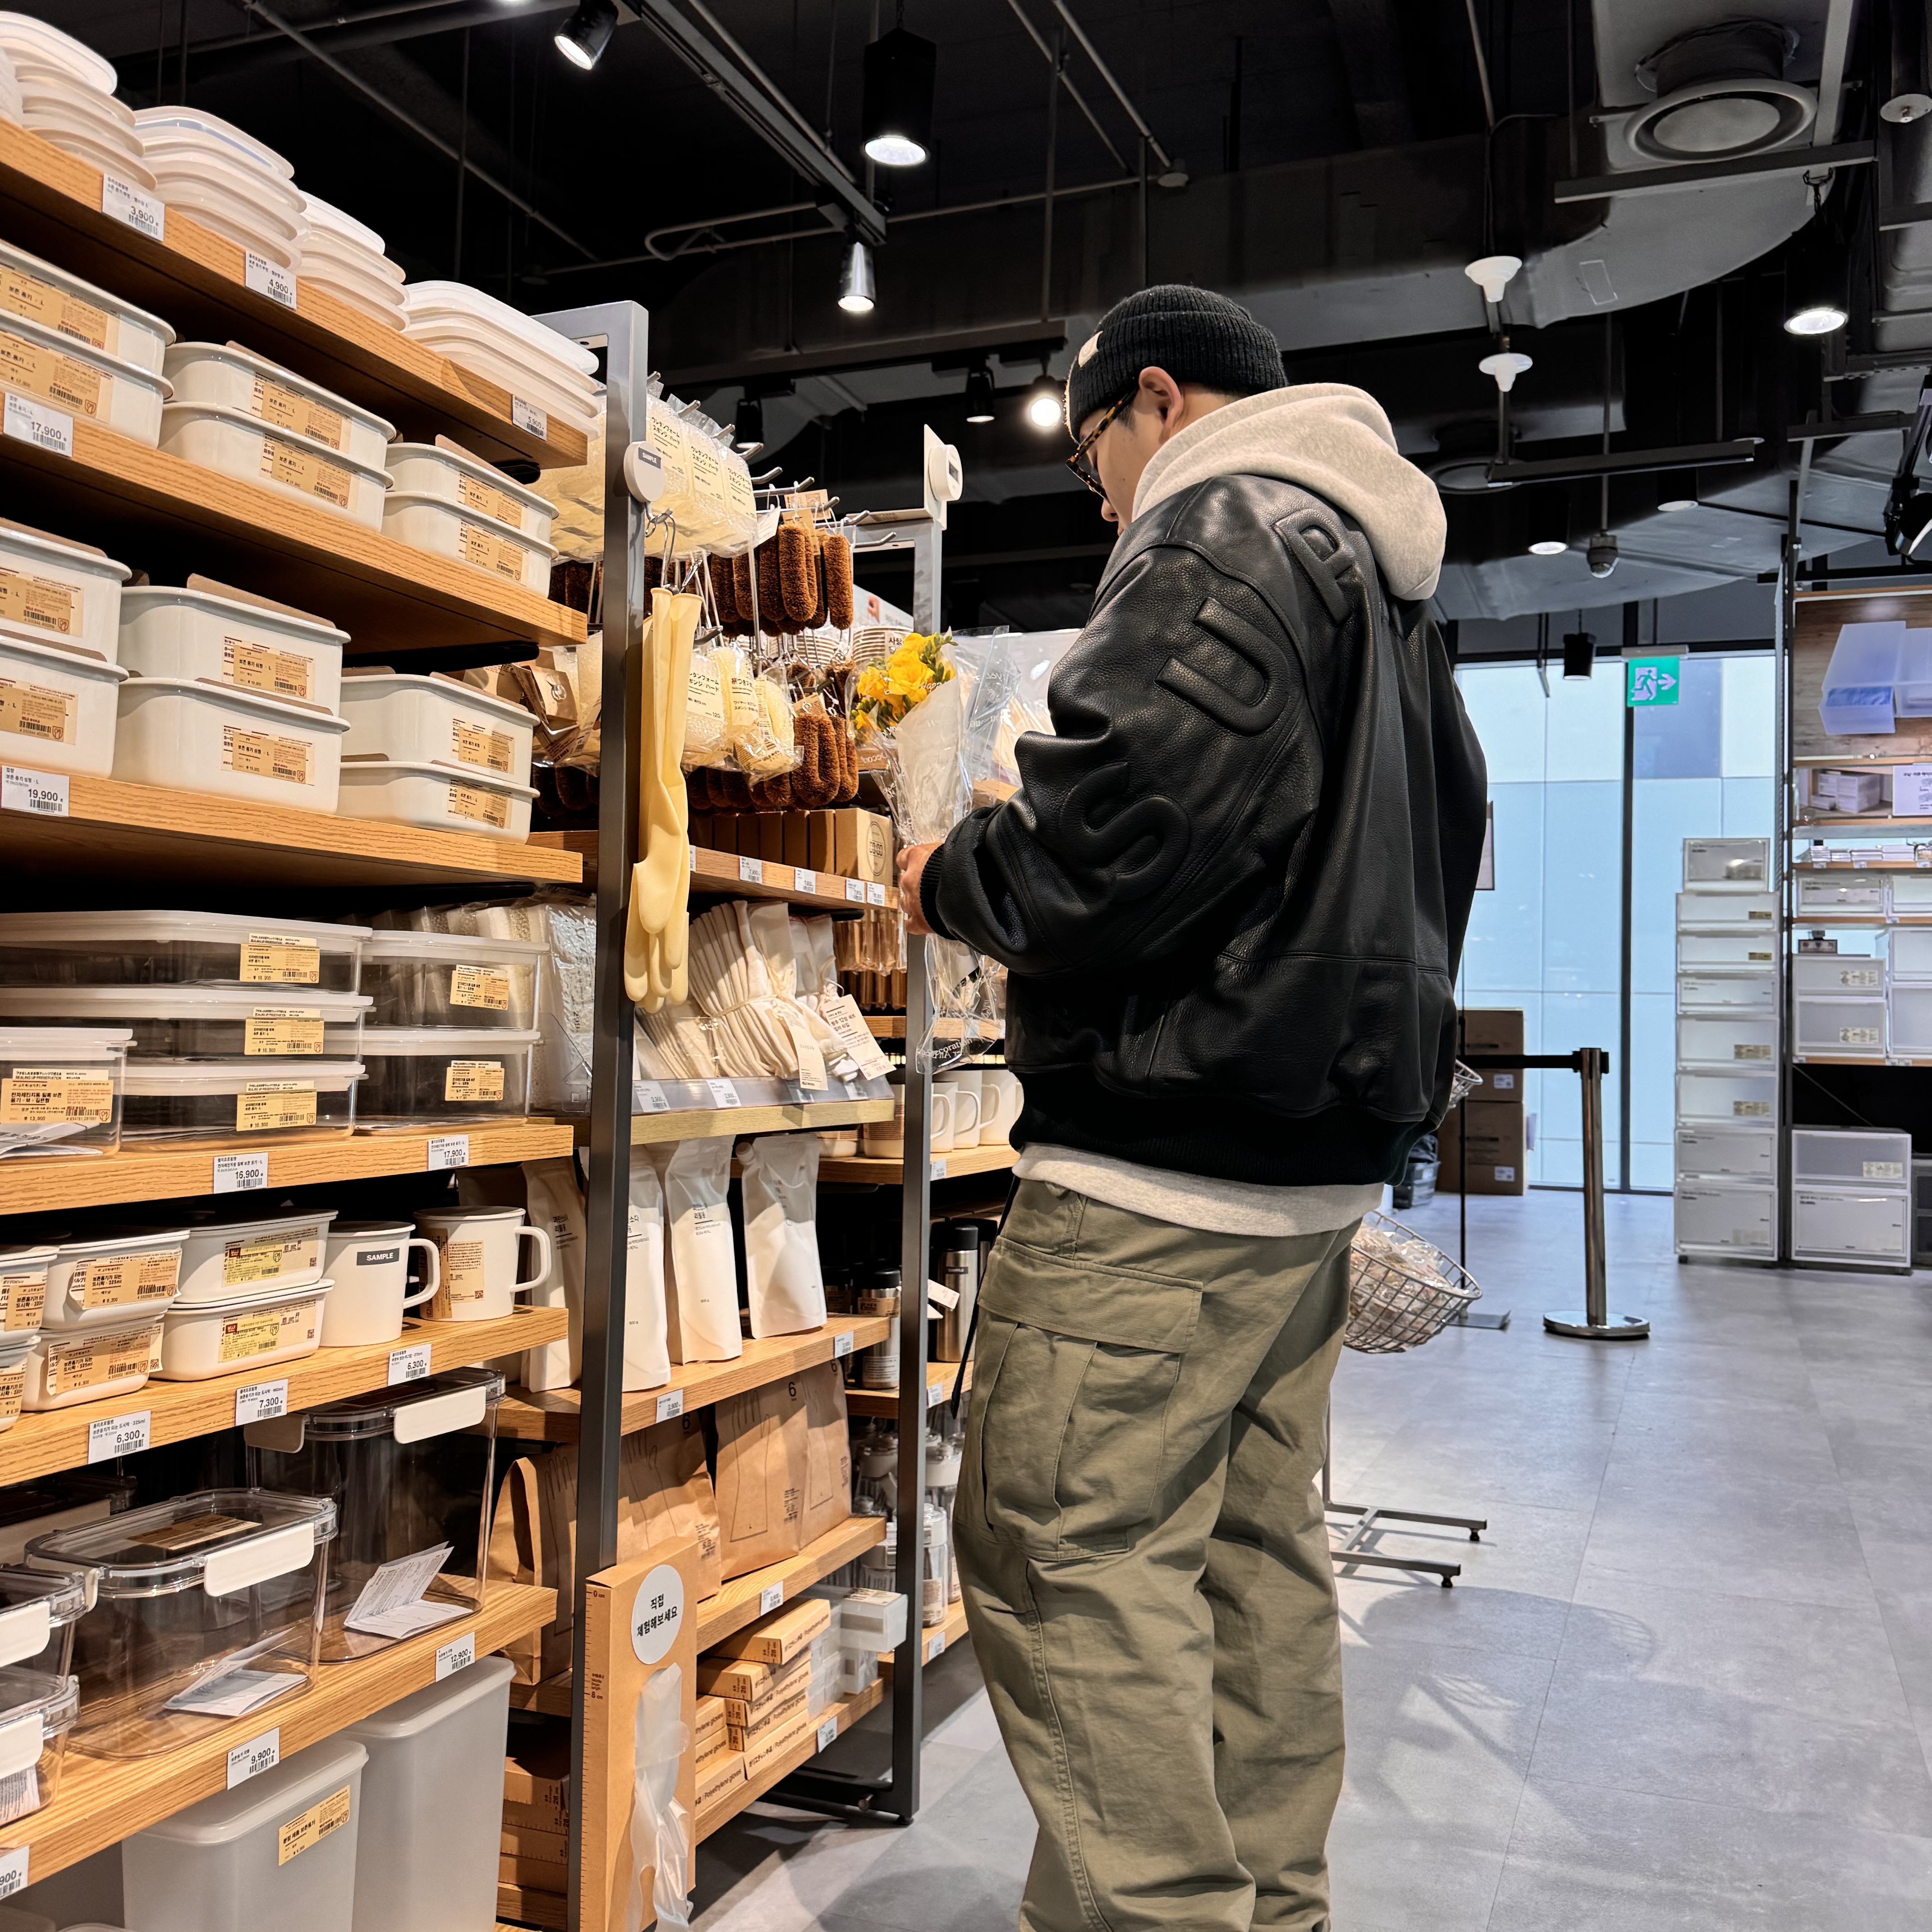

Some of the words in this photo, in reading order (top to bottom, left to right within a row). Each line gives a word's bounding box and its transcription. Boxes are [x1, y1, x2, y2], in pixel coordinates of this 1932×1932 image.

[31, 421, 61, 439] 17,900
[28, 789, 58, 801] 19,900
[444, 1150, 462, 1158] 17,900
[235, 1169, 259, 1179] 16,900
[367, 1252, 394, 1261] SAMPLE
[408, 1360, 423, 1370] 6,300
[789, 1382, 796, 1397] 6
[259, 1397, 279, 1408] 7,300
[682, 1413, 691, 1430] 6
[117, 1430, 140, 1443] 6,300
[651, 1594, 664, 1610] 직접
[637, 1606, 677, 1637] 체험해보세요
[451, 1649, 468, 1663] 12,900
[252, 1748, 271, 1764] 9,900
